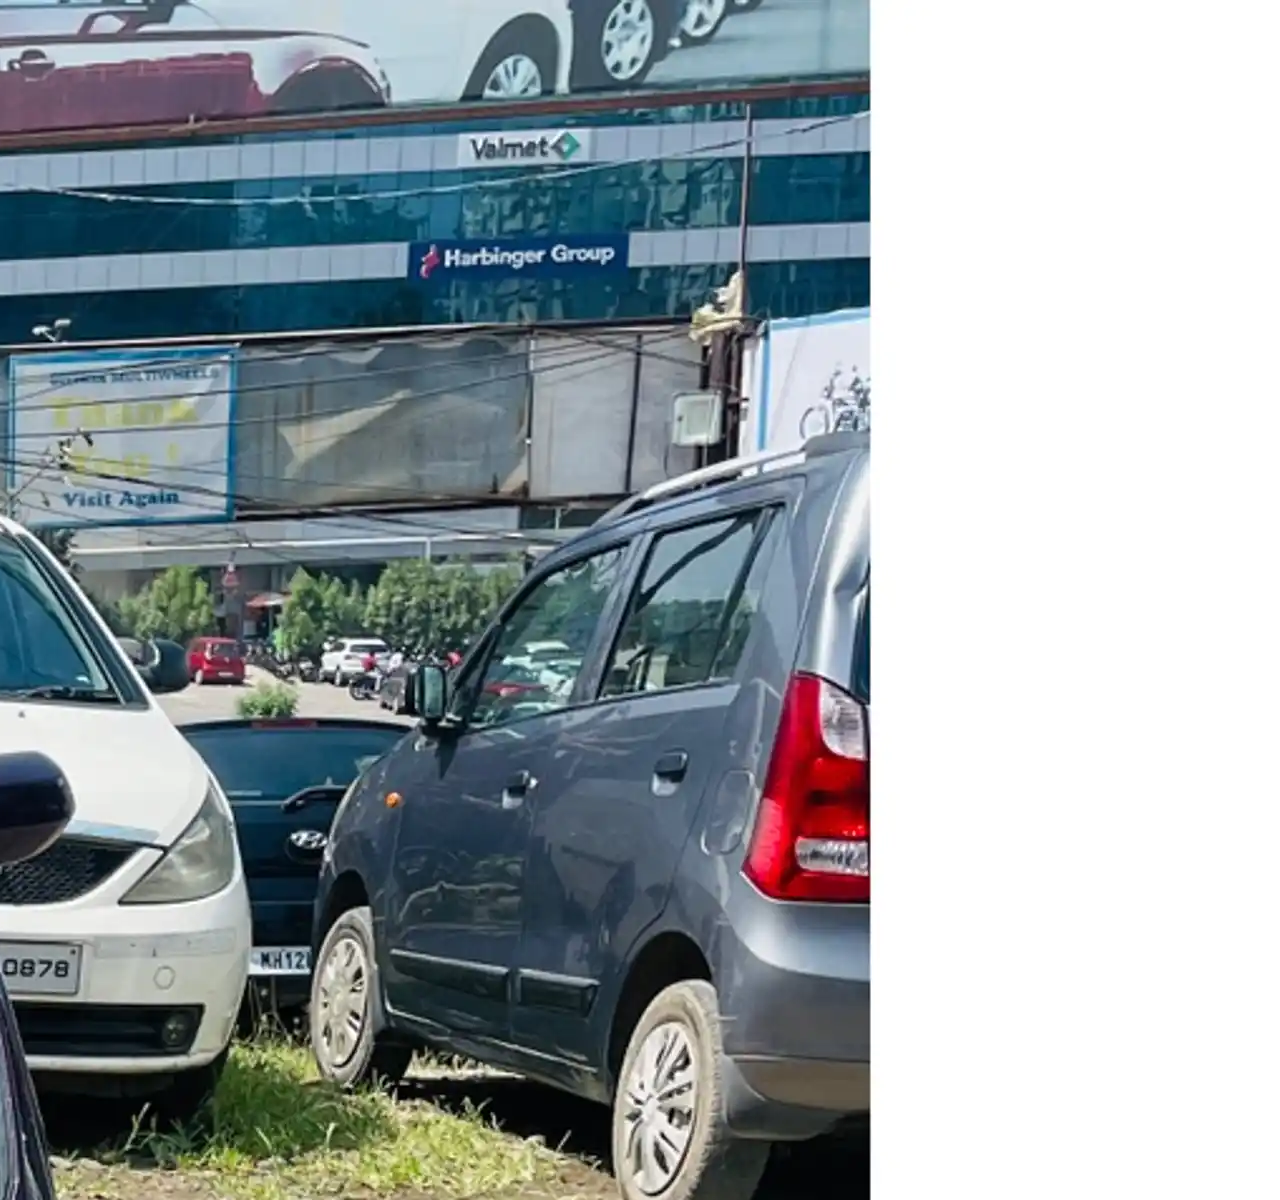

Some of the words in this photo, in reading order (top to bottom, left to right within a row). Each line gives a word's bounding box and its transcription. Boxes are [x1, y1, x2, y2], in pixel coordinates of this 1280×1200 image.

[470, 137, 549, 160] Valmet
[444, 246, 546, 269] Harbinger
[551, 244, 616, 266] Group
[63, 491, 112, 507] Visit
[119, 490, 180, 508] Again
[2, 957, 70, 980] 0878
